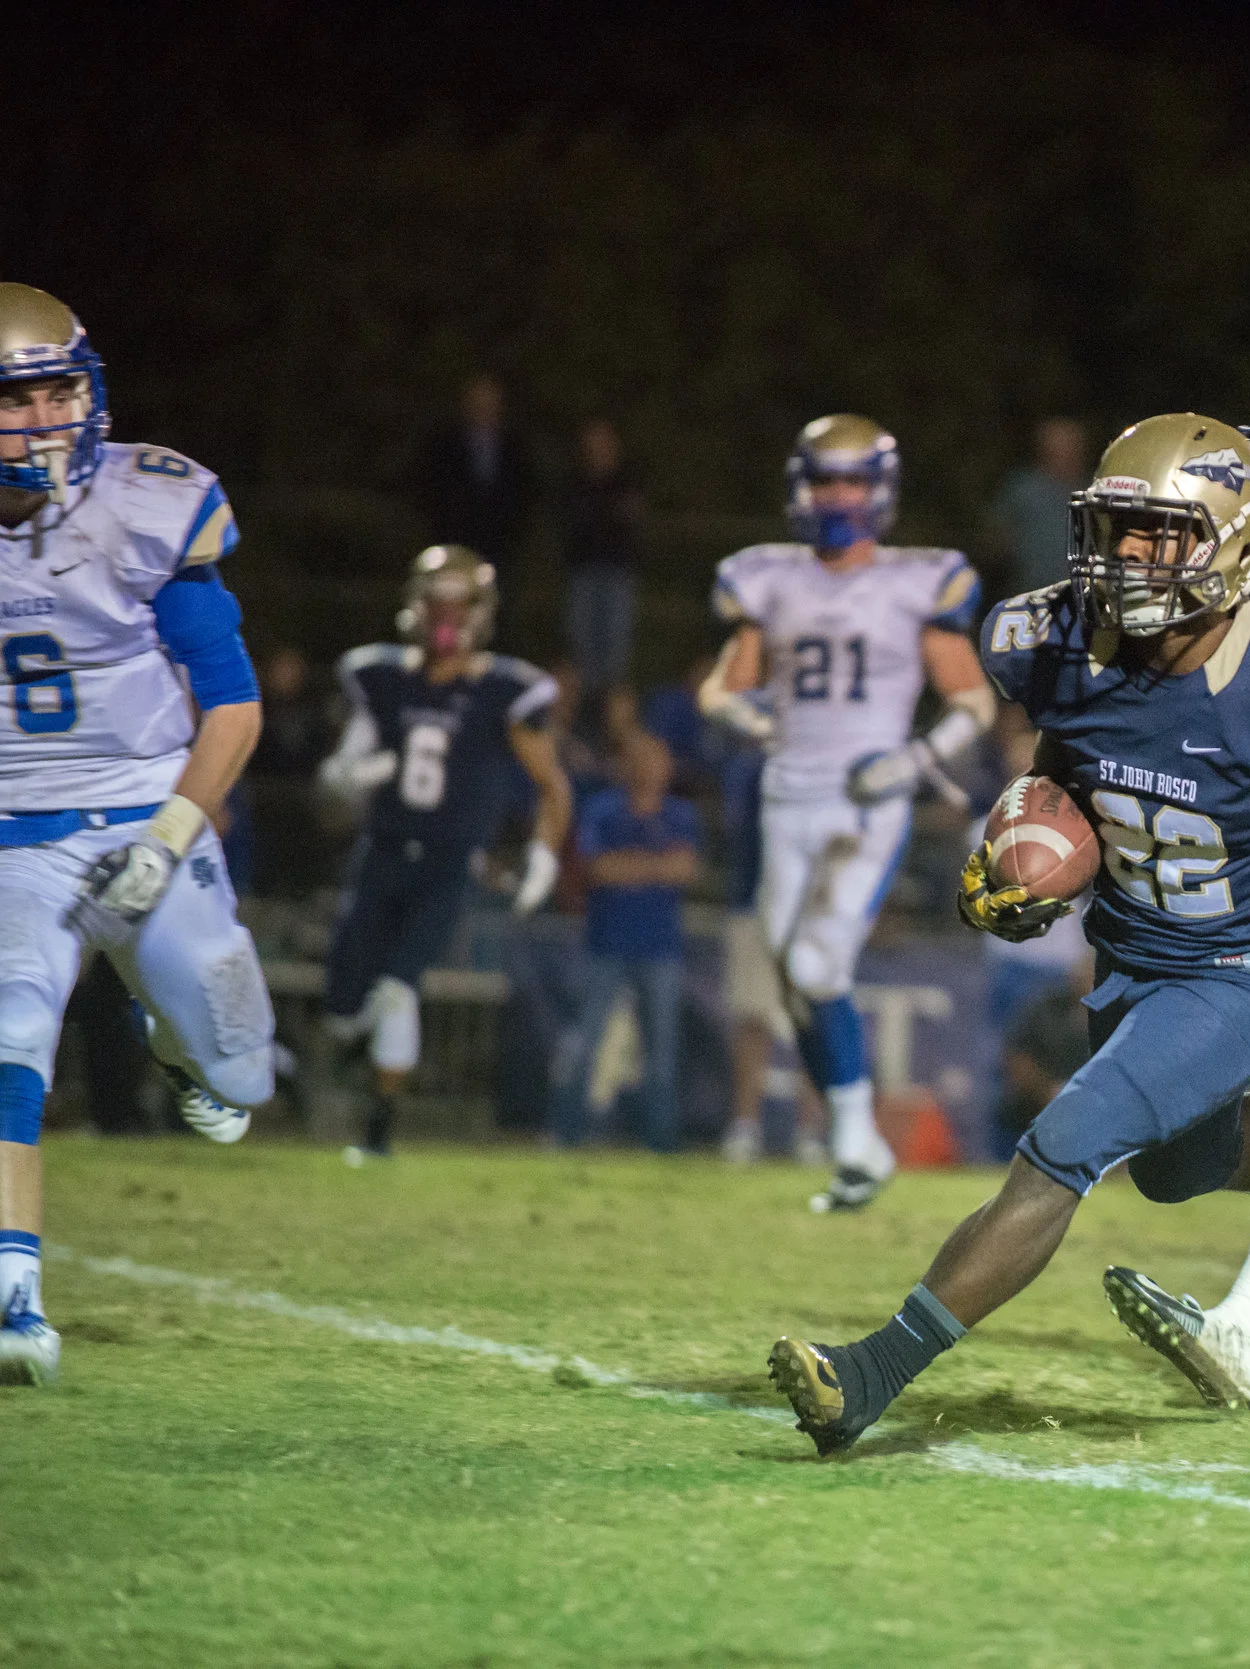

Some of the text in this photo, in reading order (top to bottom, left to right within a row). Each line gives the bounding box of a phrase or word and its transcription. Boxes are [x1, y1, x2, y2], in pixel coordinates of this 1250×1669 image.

[1105, 478, 1137, 491] Riddell
[2, 631, 79, 737] 6
[793, 635, 866, 703] 21
[1099, 759, 1198, 803] ST. JOHN BOSCO
[1091, 788, 1236, 919] 22
